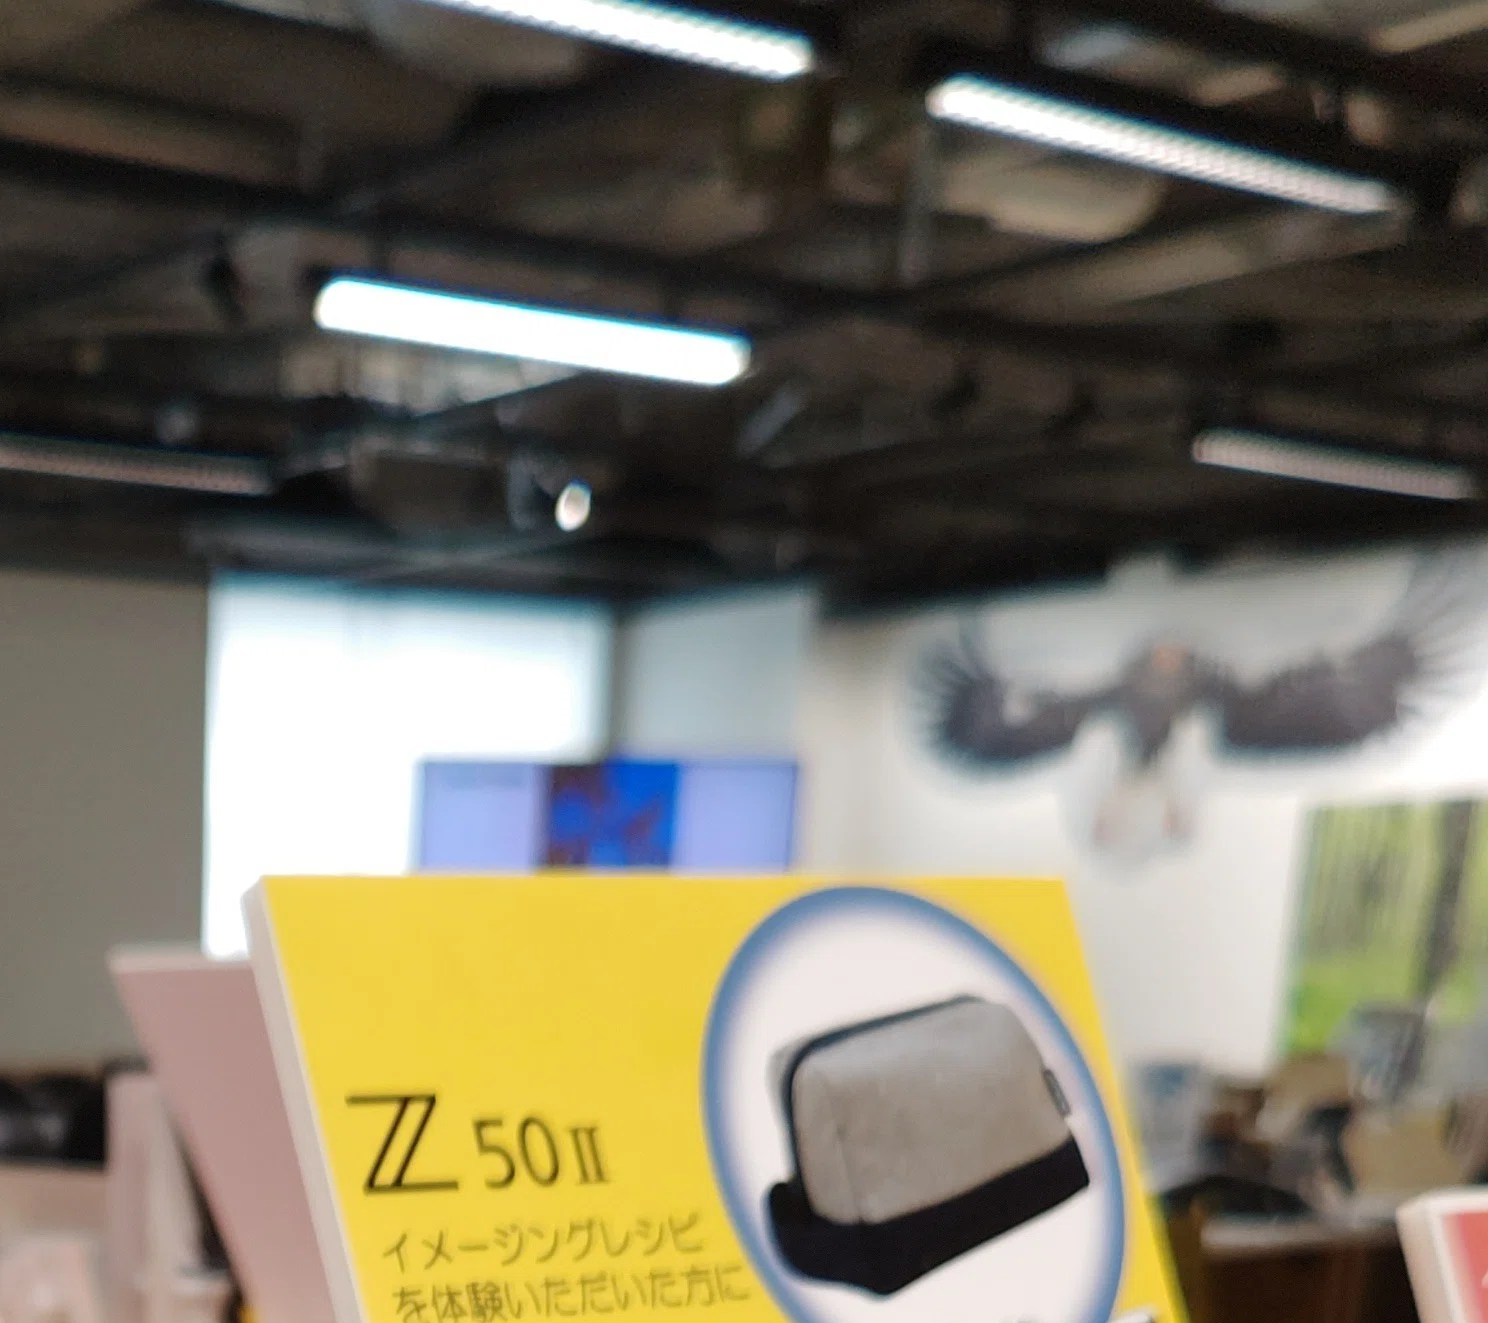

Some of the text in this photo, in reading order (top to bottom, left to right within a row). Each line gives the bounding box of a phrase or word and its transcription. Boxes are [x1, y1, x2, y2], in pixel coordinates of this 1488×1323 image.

[383, 1212, 704, 1273] イメージングレシピ
